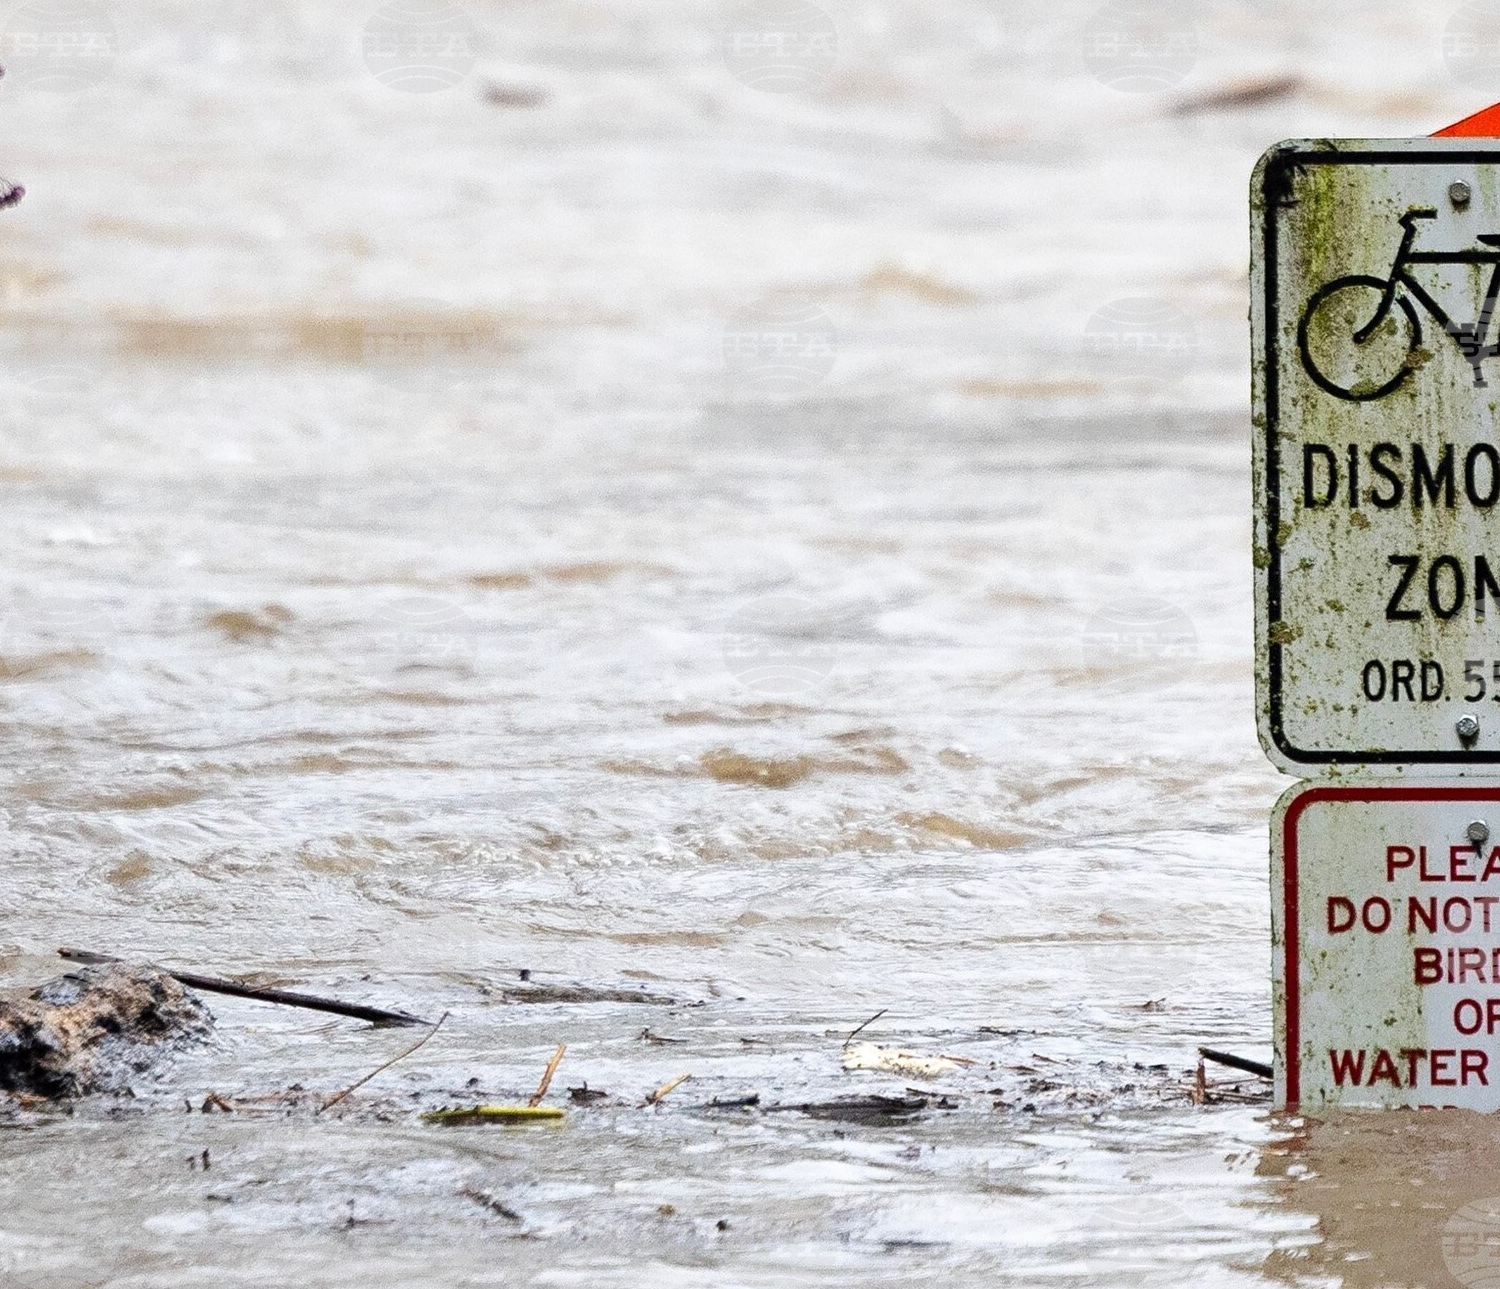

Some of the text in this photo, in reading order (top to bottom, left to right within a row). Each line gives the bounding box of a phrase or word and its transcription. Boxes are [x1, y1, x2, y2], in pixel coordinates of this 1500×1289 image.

[1361, 658, 1451, 703] ORD.
[1327, 896, 1392, 934] DO
[1408, 896, 1499, 934] NOT
[1329, 1048, 1489, 1088] WATER
